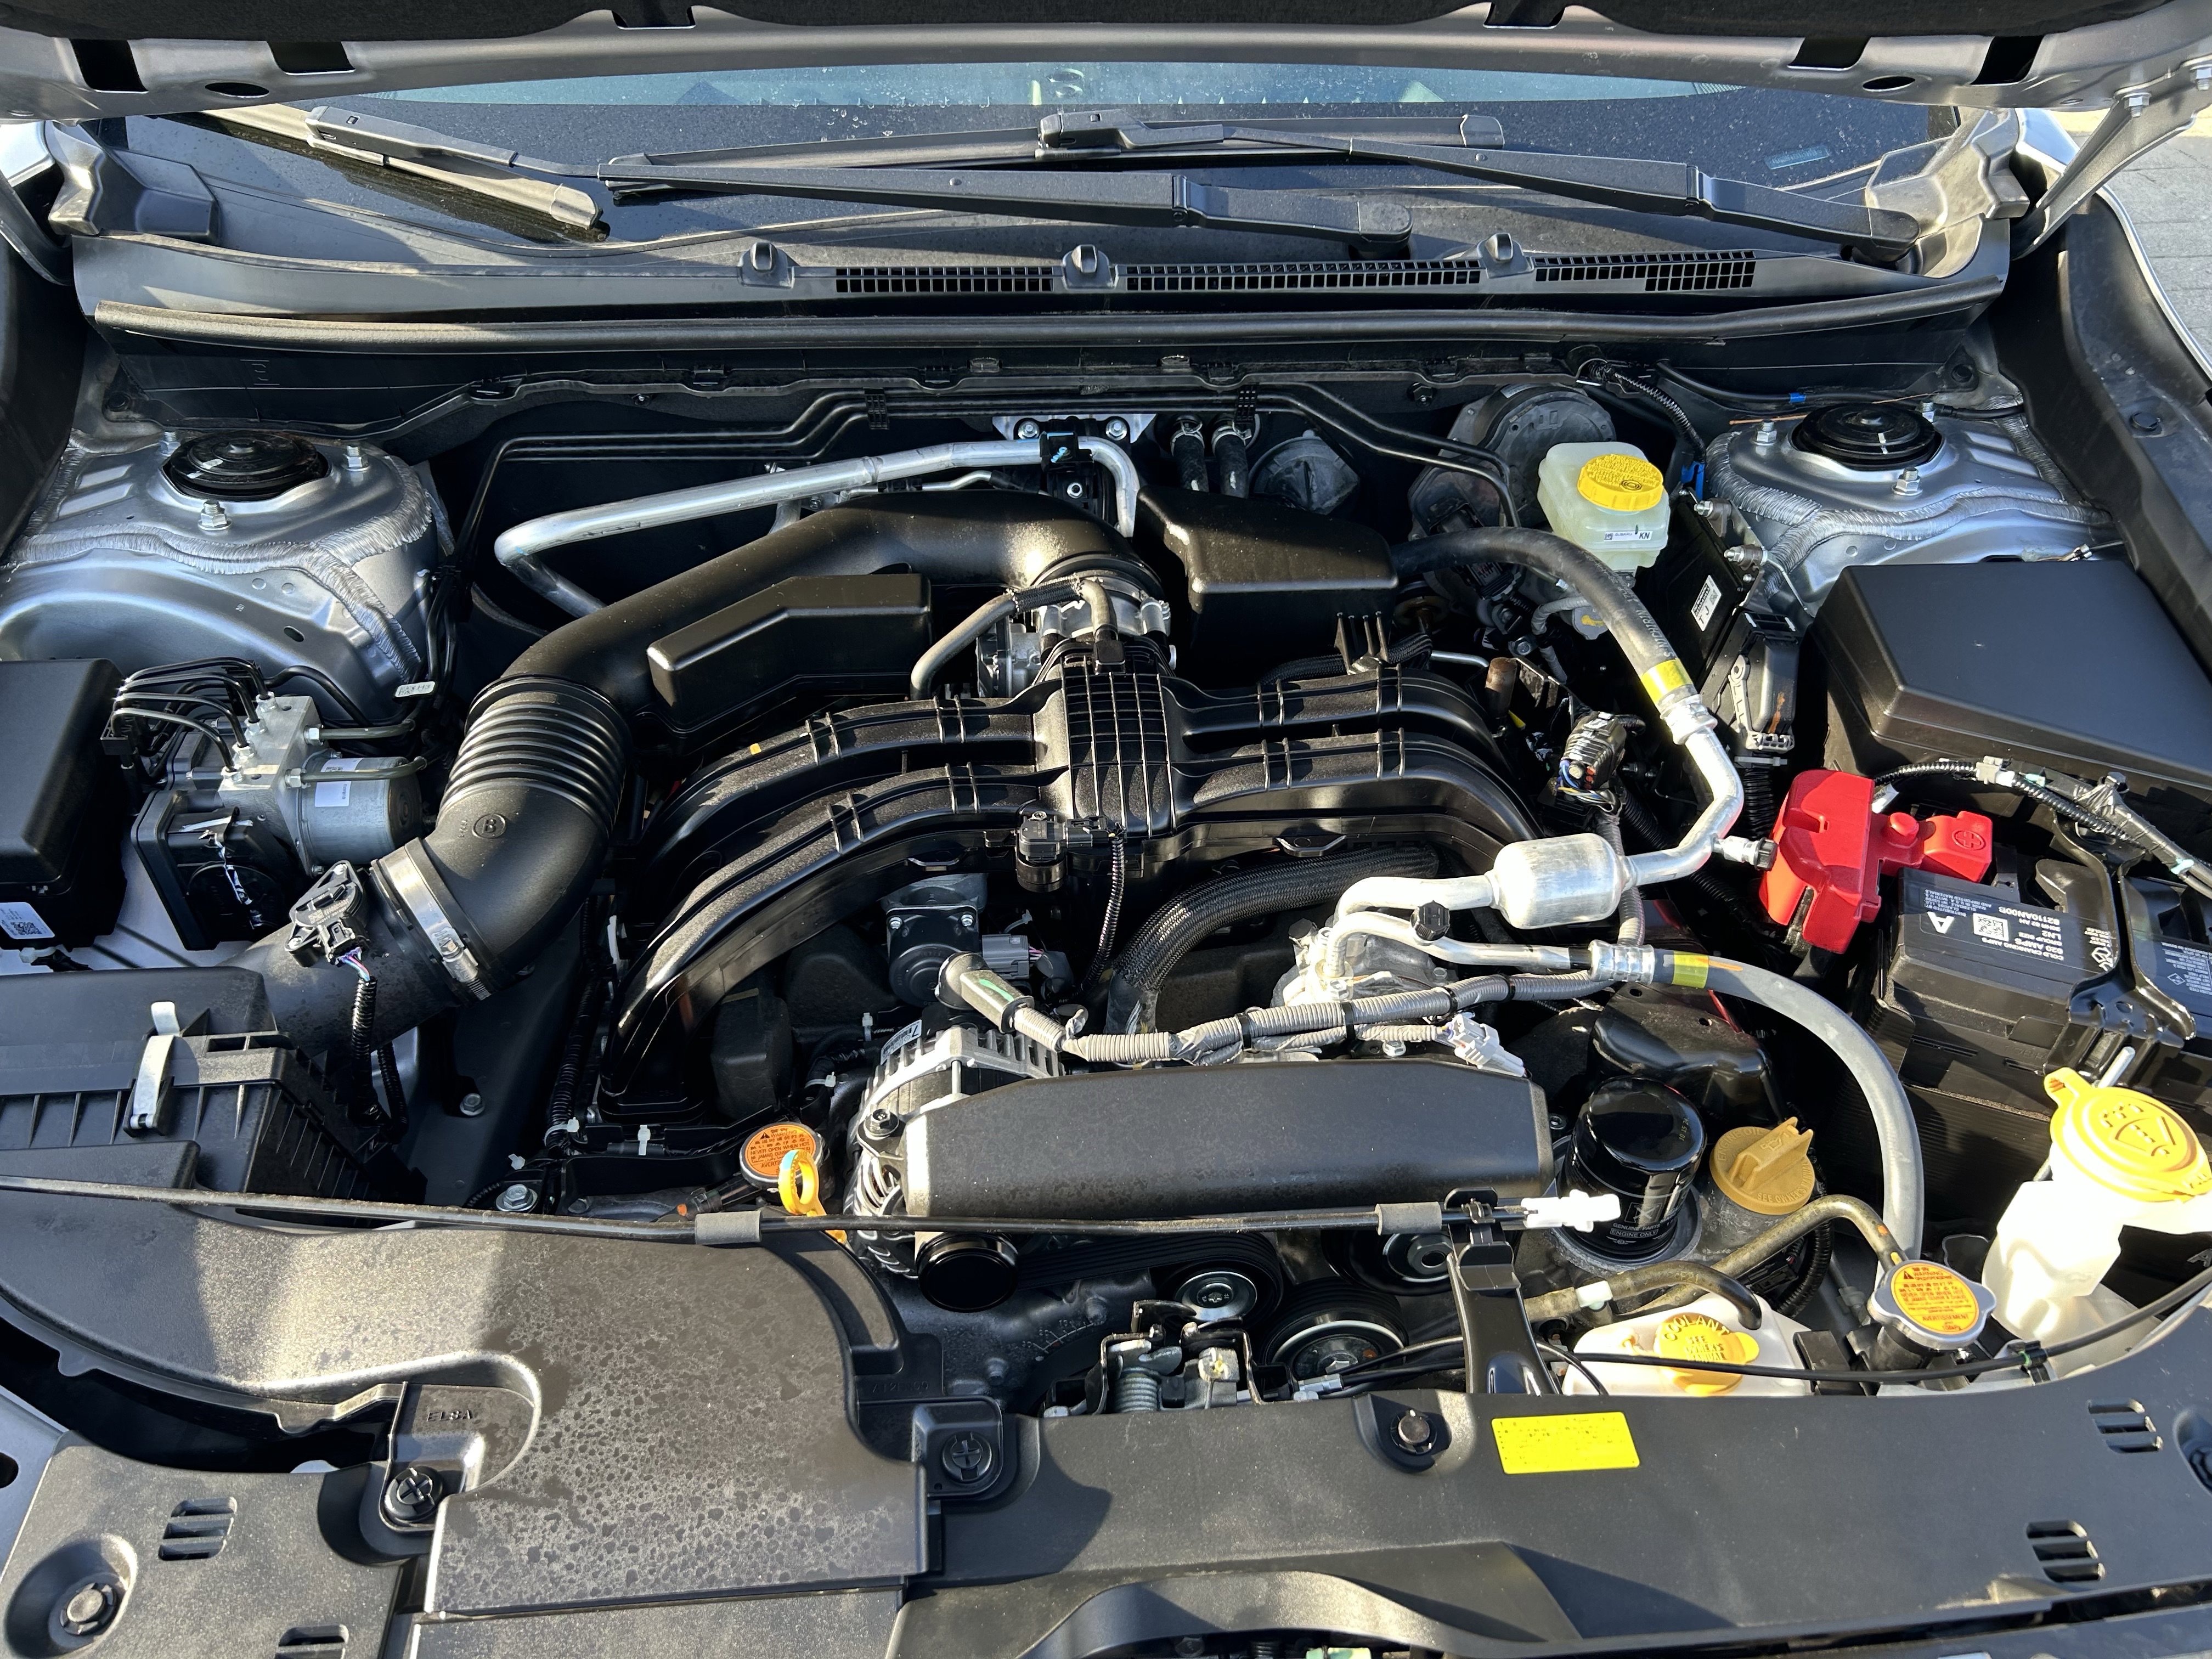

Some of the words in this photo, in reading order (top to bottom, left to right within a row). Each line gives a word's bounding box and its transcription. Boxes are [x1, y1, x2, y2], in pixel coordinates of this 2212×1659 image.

[1933, 906, 1967, 917] DISTRIBUTED
[2041, 930, 2062, 940] LN2
[1982, 937, 2002, 947] AMPS
[2015, 938, 2044, 950] AMPS
[2035, 936, 2062, 946] GROUP
[2004, 943, 2042, 955] CRANKING
[2045, 945, 2063, 955] 620
[2043, 951, 2064, 961] COLD
[1718, 1131, 1741, 1161] ENGINE
[1757, 1193, 1773, 1203] SEE
[1613, 1222, 1640, 1231] GENUINE
[1611, 1229, 1639, 1237] ENGINE
[1663, 1314, 1729, 1341] COOLANT
[1686, 1335, 1706, 1344] SEE
[1687, 1352, 1728, 1363] MANUAL
